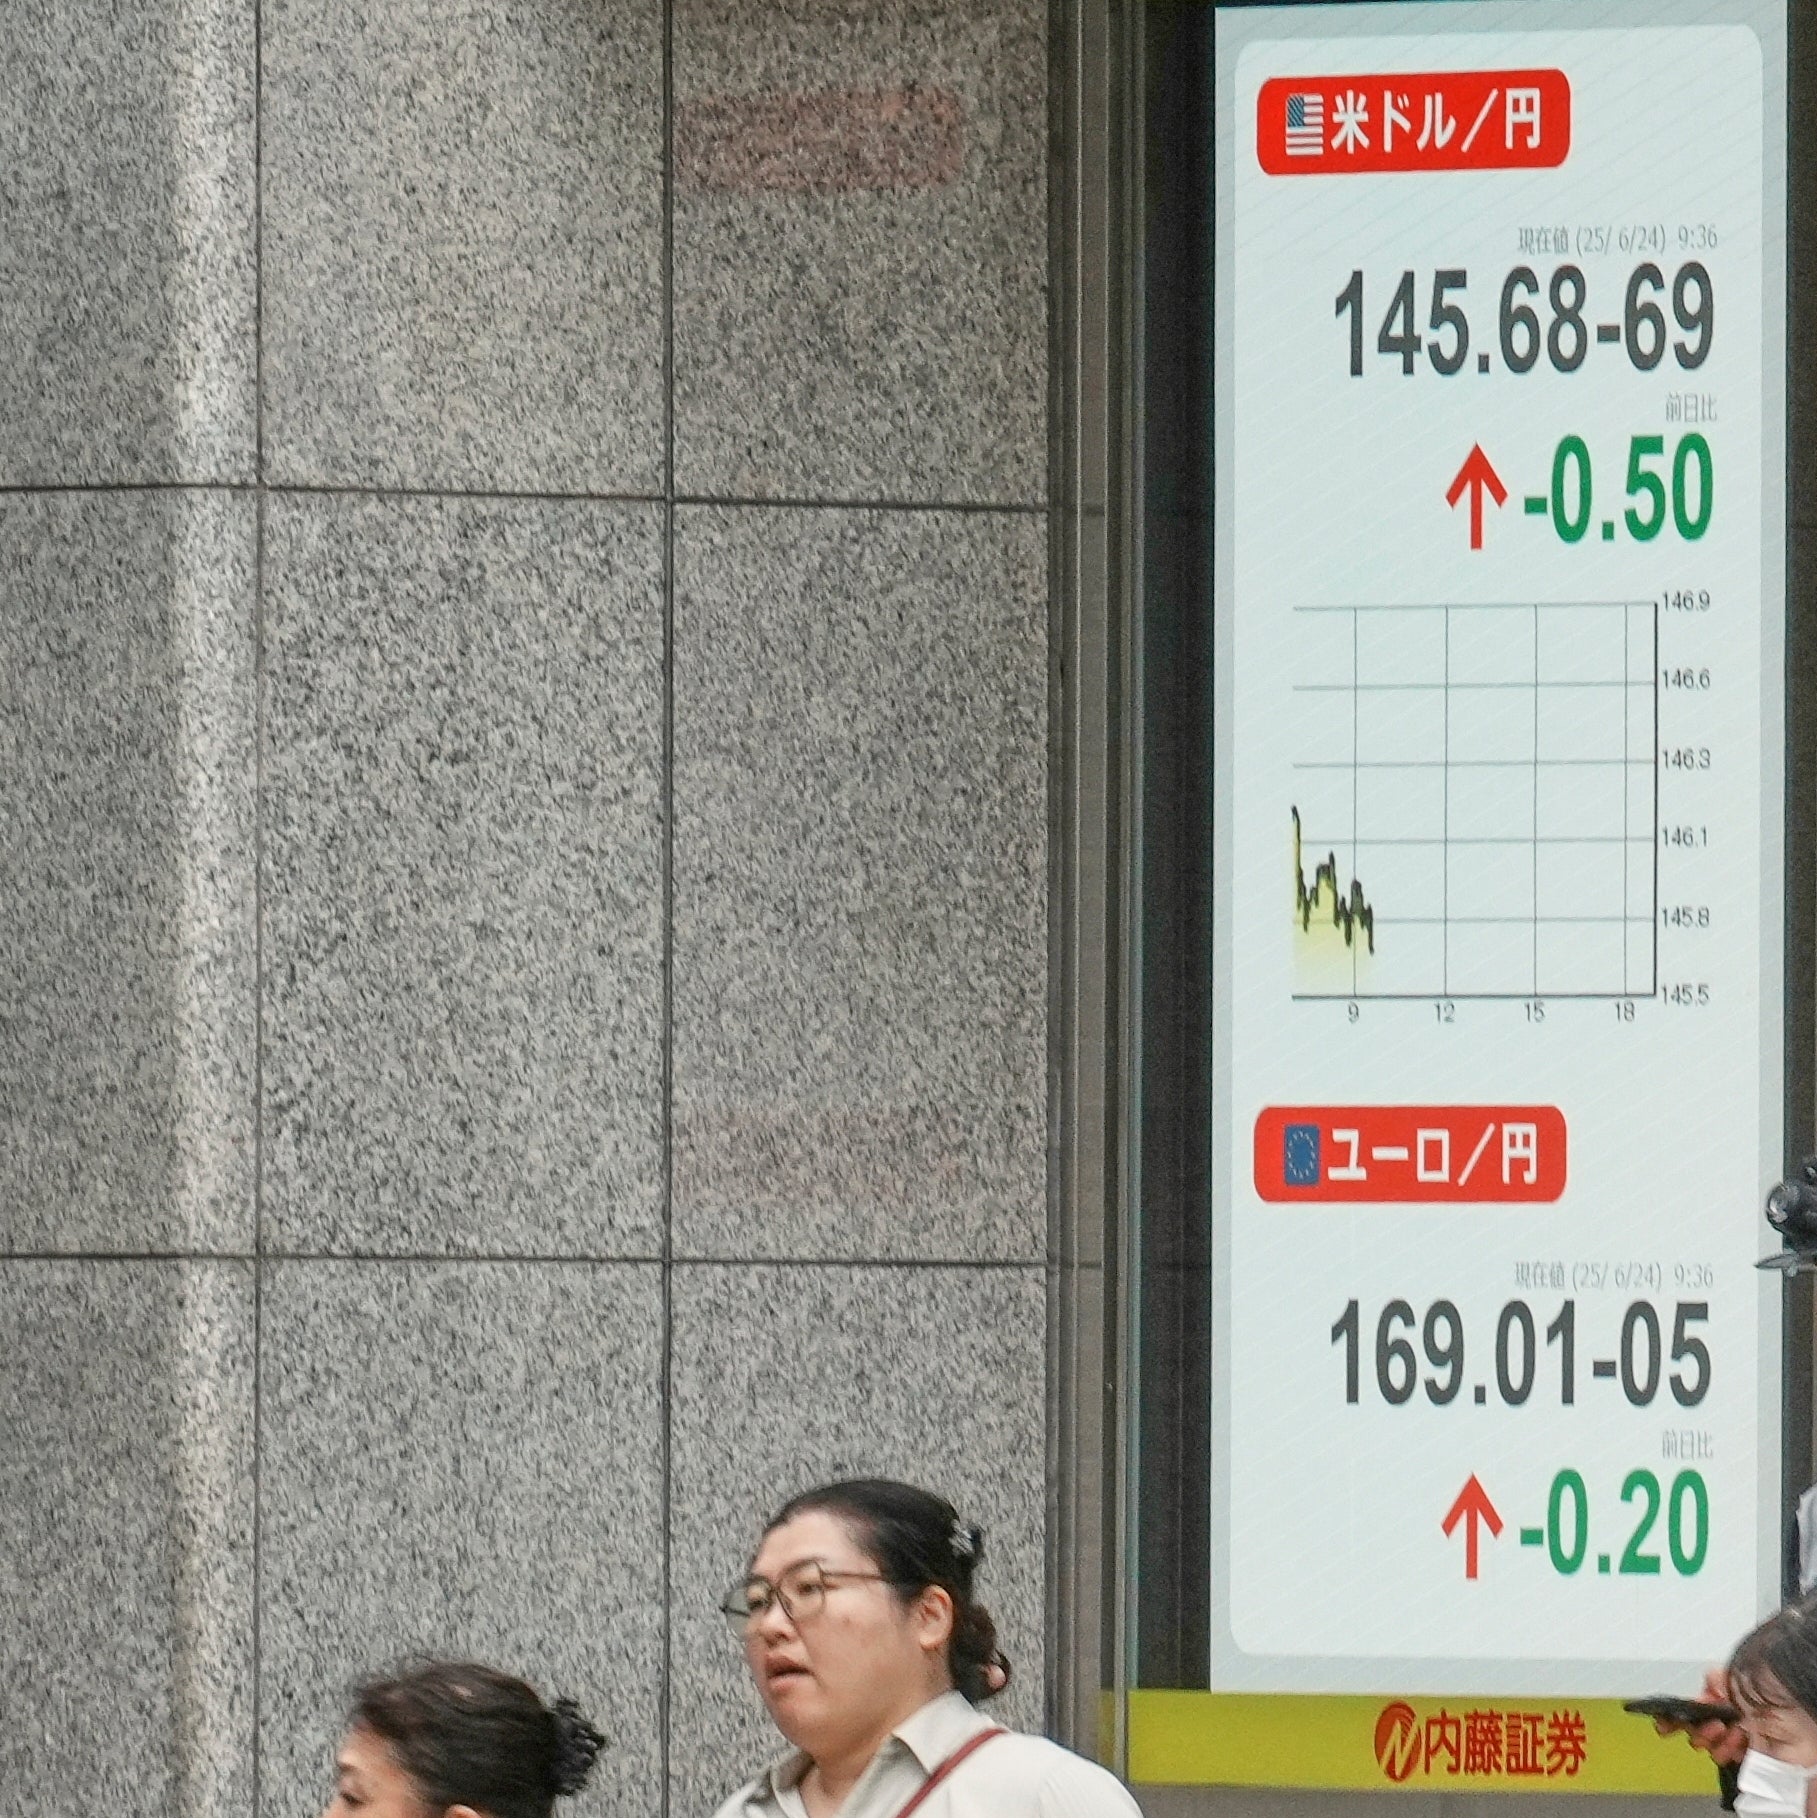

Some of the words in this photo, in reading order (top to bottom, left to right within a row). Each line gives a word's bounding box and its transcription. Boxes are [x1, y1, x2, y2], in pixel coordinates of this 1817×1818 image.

[1330, 87, 1542, 155] 米ドル／円
[1518, 226, 1570, 256] 現在値
[1678, 223, 1718, 250] 9:36
[1334, 262, 1715, 378] 145.68-69
[1665, 393, 1718, 424] 前日比
[1524, 432, 1714, 546] -0.50
[1662, 590, 1712, 612] 146.9
[1662, 669, 1711, 690] 146.6
[1662, 749, 1711, 770] 146.3
[1662, 827, 1708, 848] 146.1
[1662, 907, 1711, 929] 145.8
[1662, 985, 1710, 1006] 145.5
[1348, 1005, 1361, 1024] 9
[1436, 1005, 1456, 1024] 12
[1525, 1004, 1546, 1023] 15
[1615, 1004, 1636, 1023] 18
[1327, 1122, 1539, 1187] ユーロ／円
[1674, 1263, 1715, 1290] 9:36
[1331, 1298, 1713, 1409] 169.01-05
[1661, 1431, 1714, 1461] 前日比
[1520, 1468, 1711, 1578] -0.20
[1424, 1711, 1588, 1777] 内藤証券
